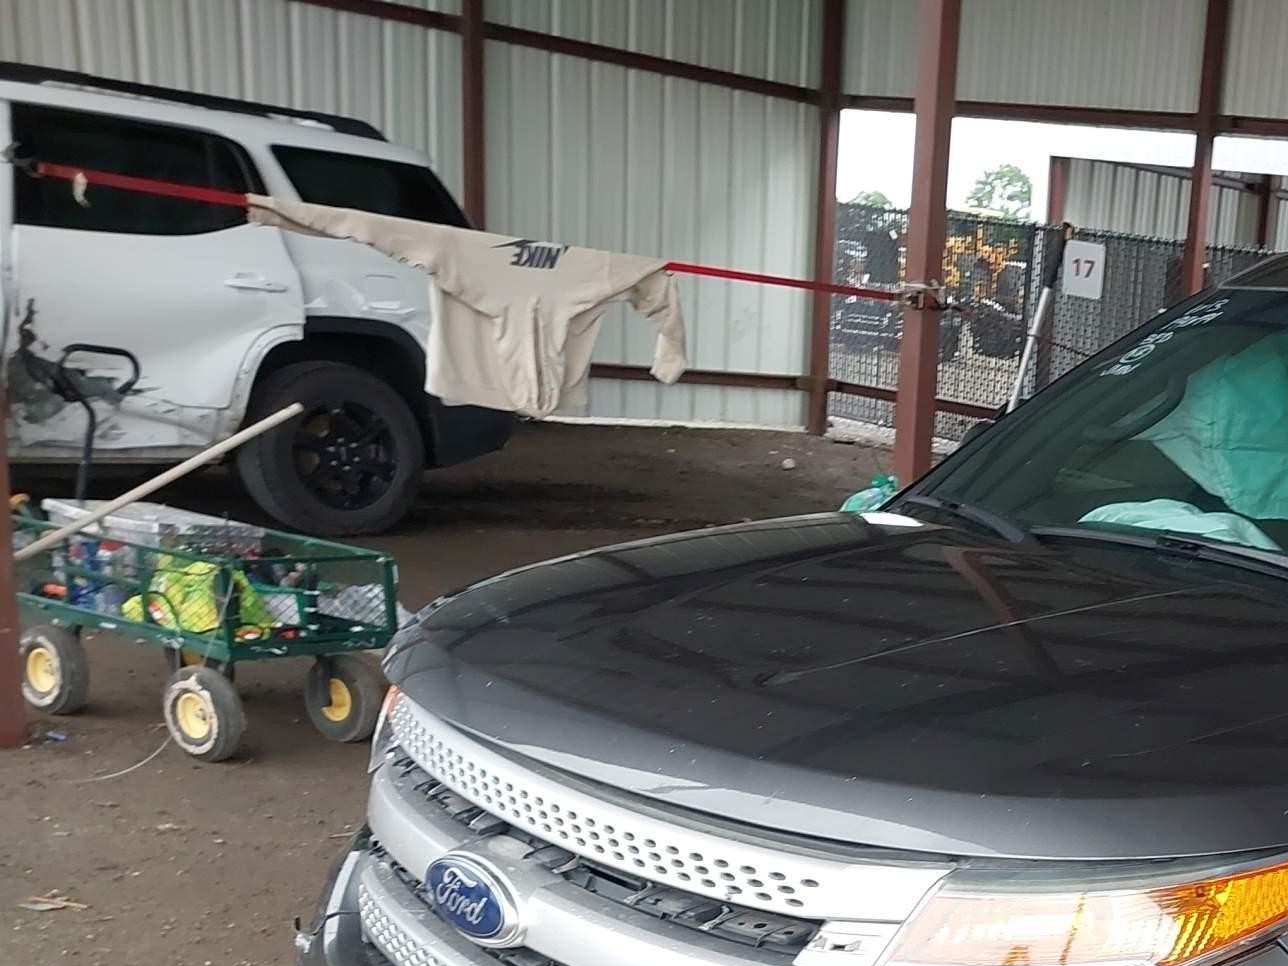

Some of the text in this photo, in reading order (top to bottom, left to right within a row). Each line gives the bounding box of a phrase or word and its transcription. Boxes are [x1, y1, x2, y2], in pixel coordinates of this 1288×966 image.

[509, 244, 561, 269] NIKE
[1072, 258, 1096, 279] 17
[436, 866, 489, 926] Ford
